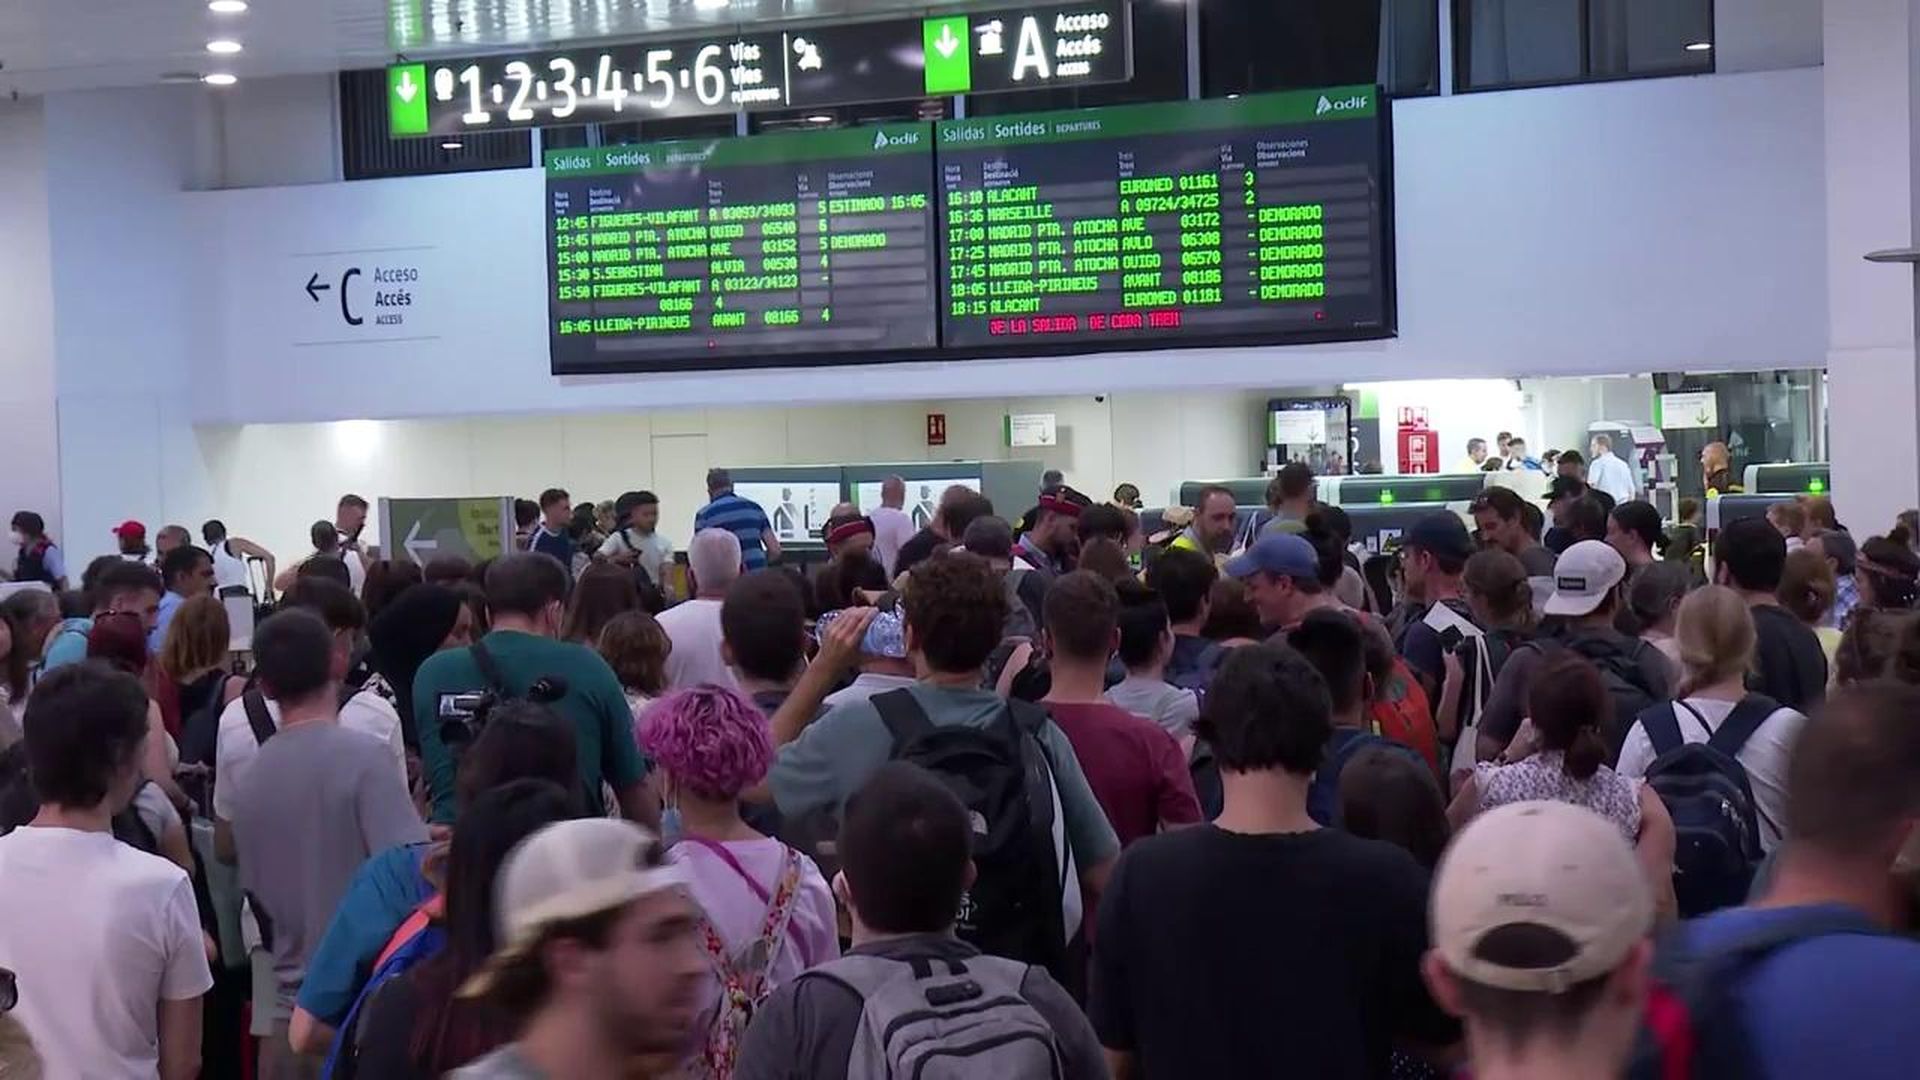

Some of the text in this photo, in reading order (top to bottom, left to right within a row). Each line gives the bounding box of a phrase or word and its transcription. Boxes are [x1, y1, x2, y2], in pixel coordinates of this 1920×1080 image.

[1055, 13, 1109, 33] Acceso
[1012, 16, 1050, 80] A
[1056, 34, 1102, 57] Accés
[890, 132, 918, 145] adif
[943, 128, 985, 142] Salidas
[995, 122, 1045, 138] Sortides
[554, 157, 591, 171] Salidas
[948, 171, 1253, 206] 16:10 ALACANT EUROMED 01161 3
[556, 194, 927, 230] 12:45 FIGUERES-VILAFANT A 03093/34093 5 ESTIMADO 16:05
[988, 204, 1052, 221] MARSEILLE
[1121, 199, 1129, 213] A
[1136, 193, 1219, 212] 09724/34725
[1246, 190, 1254, 204] 2
[557, 233, 589, 247] 13:45
[591, 231, 631, 245] MADRID
[635, 229, 660, 243] PTA.
[667, 226, 707, 241] ATOCHA
[710, 224, 745, 239] OUIGO
[818, 218, 827, 233] 6
[950, 227, 984, 242] 17:00
[988, 224, 1033, 240] MADRID
[1037, 222, 1065, 237] PTA.
[1073, 219, 1118, 235] ATOCHA
[1122, 217, 1145, 231] AVE
[1181, 212, 1219, 228] 03172
[1259, 205, 1322, 223] DEMORADO
[558, 233, 887, 264] 15:00 MADRID PTA. ATOCHA AVE 03152 5 DEMORADO
[950, 245, 985, 260] 17:25
[989, 243, 1033, 258] MADRID
[1038, 241, 1065, 255] PTA.
[1074, 238, 1118, 253] ATOCHA
[1122, 235, 1152, 250] AVLO
[1260, 224, 1322, 242] DEMORADO
[374, 267, 418, 283] Acceso
[558, 268, 590, 282] 15:30
[593, 264, 663, 280] S.SEBASTIAN
[711, 259, 745, 274] ALVIA
[820, 254, 828, 268] 4
[951, 264, 985, 279] 17:45
[989, 261, 1033, 277] MADRID
[1038, 259, 1066, 274] PTA.
[1074, 256, 1119, 272] ATOCHA
[1123, 254, 1161, 269] OUIGO
[1260, 244, 1323, 261] DEMORADO
[593, 280, 701, 297] FIGUERES-VILAFANT
[711, 278, 721, 292] A
[724, 274, 798, 291] 03123/34123
[951, 282, 986, 297] 18:05
[990, 276, 1098, 295] LLEIDA-PIRINEUS
[1123, 273, 1161, 288] AVANT
[1261, 263, 1323, 280] DEMORADO
[340, 267, 364, 326] C
[375, 288, 412, 307] Accés
[715, 296, 723, 309] 4
[952, 300, 986, 315] 18:15
[990, 298, 1040, 313] ALACANT
[1124, 291, 1177, 306] EUROMED
[1183, 288, 1221, 304] 01181
[1261, 282, 1324, 299] DEMORADO
[560, 320, 591, 333] 16:05
[594, 315, 690, 332] LLEIDA-PIRINEUS
[713, 312, 745, 326] AVANT
[821, 309, 829, 321] 4
